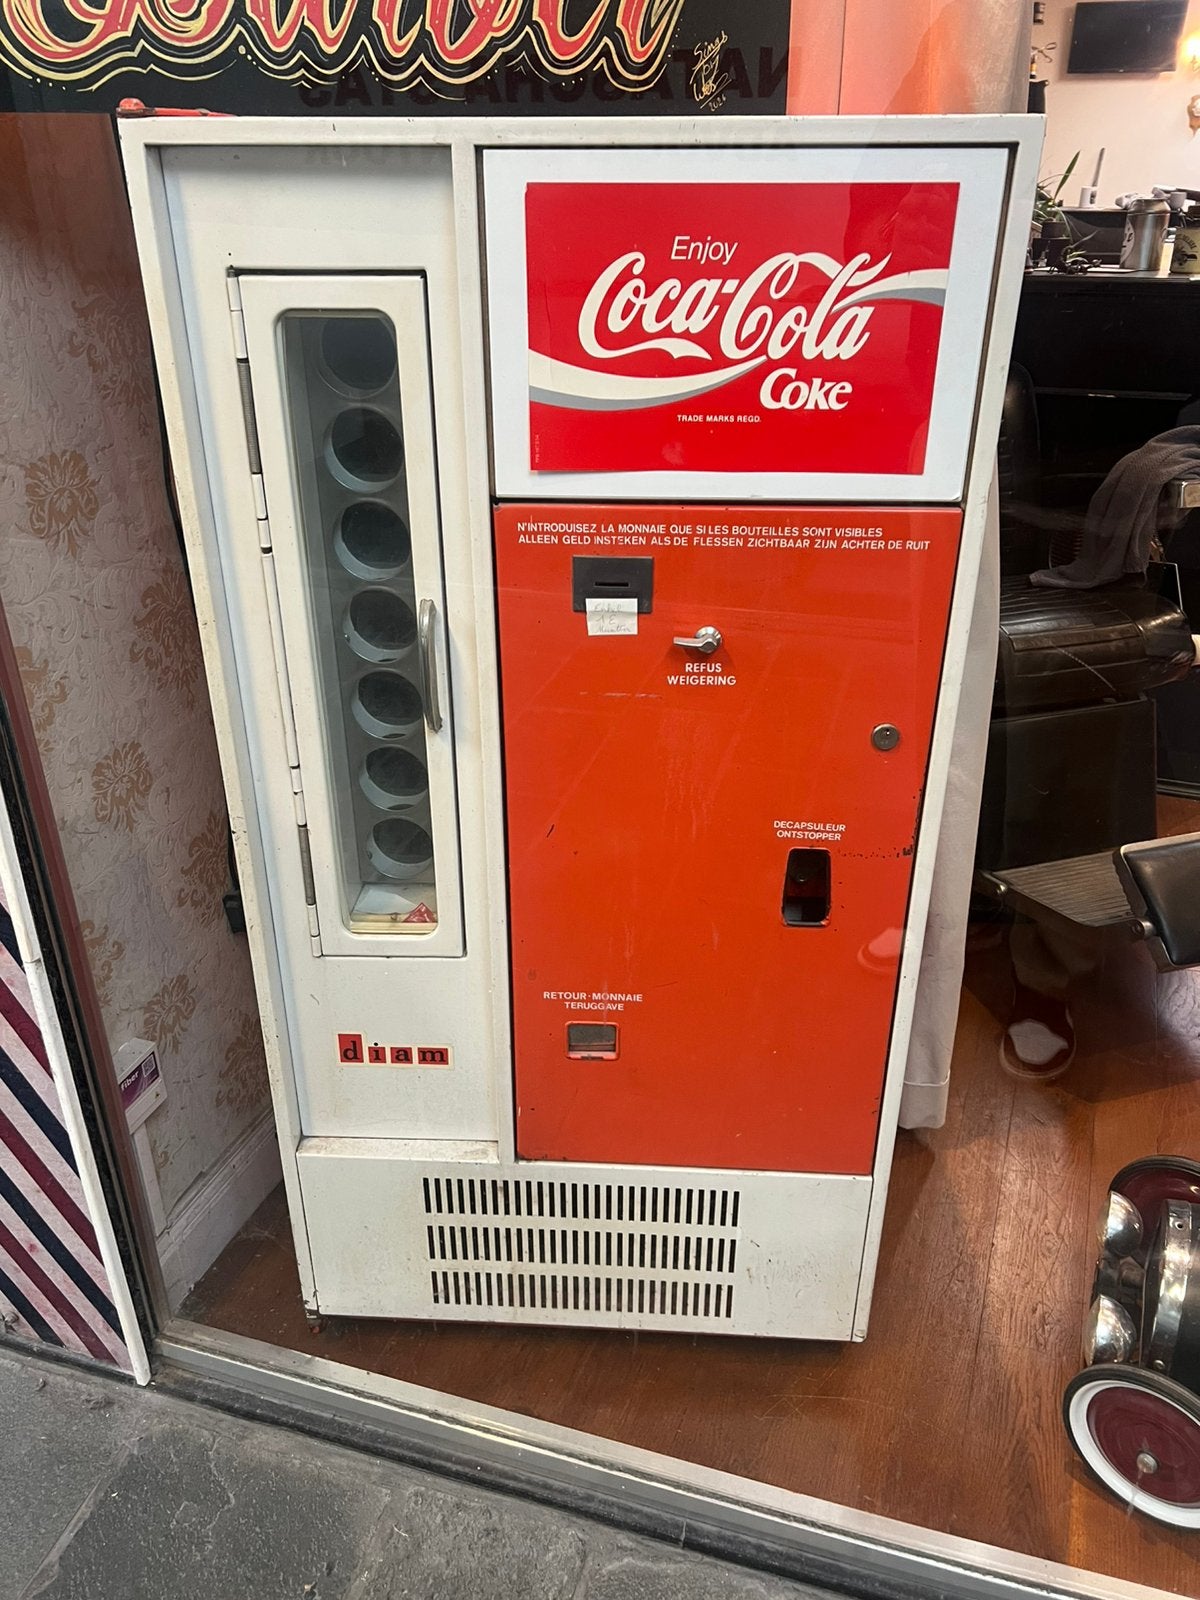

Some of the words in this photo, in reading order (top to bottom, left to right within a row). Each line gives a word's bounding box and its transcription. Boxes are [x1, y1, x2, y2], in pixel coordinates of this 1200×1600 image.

[670, 235, 738, 265] Enjoy
[578, 250, 893, 361] Coca-Cola
[760, 367, 853, 410] Coke
[676, 414, 704, 423] TRADE
[705, 414, 735, 423] MARKS
[517, 522, 597, 533] N'INTRODUISEZ
[601, 523, 615, 533] LA
[618, 524, 666, 534] MONNAIE
[669, 524, 692, 535] QUE
[695, 524, 707, 535] SI
[708, 525, 729, 535] LES
[731, 525, 799, 537] BOUTEILLES
[802, 527, 831, 537] SONT
[834, 527, 883, 538] VISIBLES
[518, 534, 558, 544] ALLEEN
[562, 535, 590, 545] GELD
[593, 535, 646, 545] INSTEKEN
[650, 536, 671, 546] ALS
[673, 536, 688, 546] DE
[693, 537, 743, 547] FLESSEN
[747, 538, 810, 548] ZICHTBAAR
[814, 539, 837, 549] ZIJN
[841, 540, 885, 550] ACHTER
[887, 540, 902, 550] DE
[905, 541, 930, 550] RUIT
[685, 662, 722, 673] REFUS
[667, 675, 737, 686] WEIGERING
[773, 820, 846, 832] DECAPSULEUR
[776, 830, 842, 840] ONTSTOPPER
[564, 1001, 624, 1011] TERUGGAVE
[342, 1039, 449, 1063] diam
[120, 1070, 139, 1091] fiber
